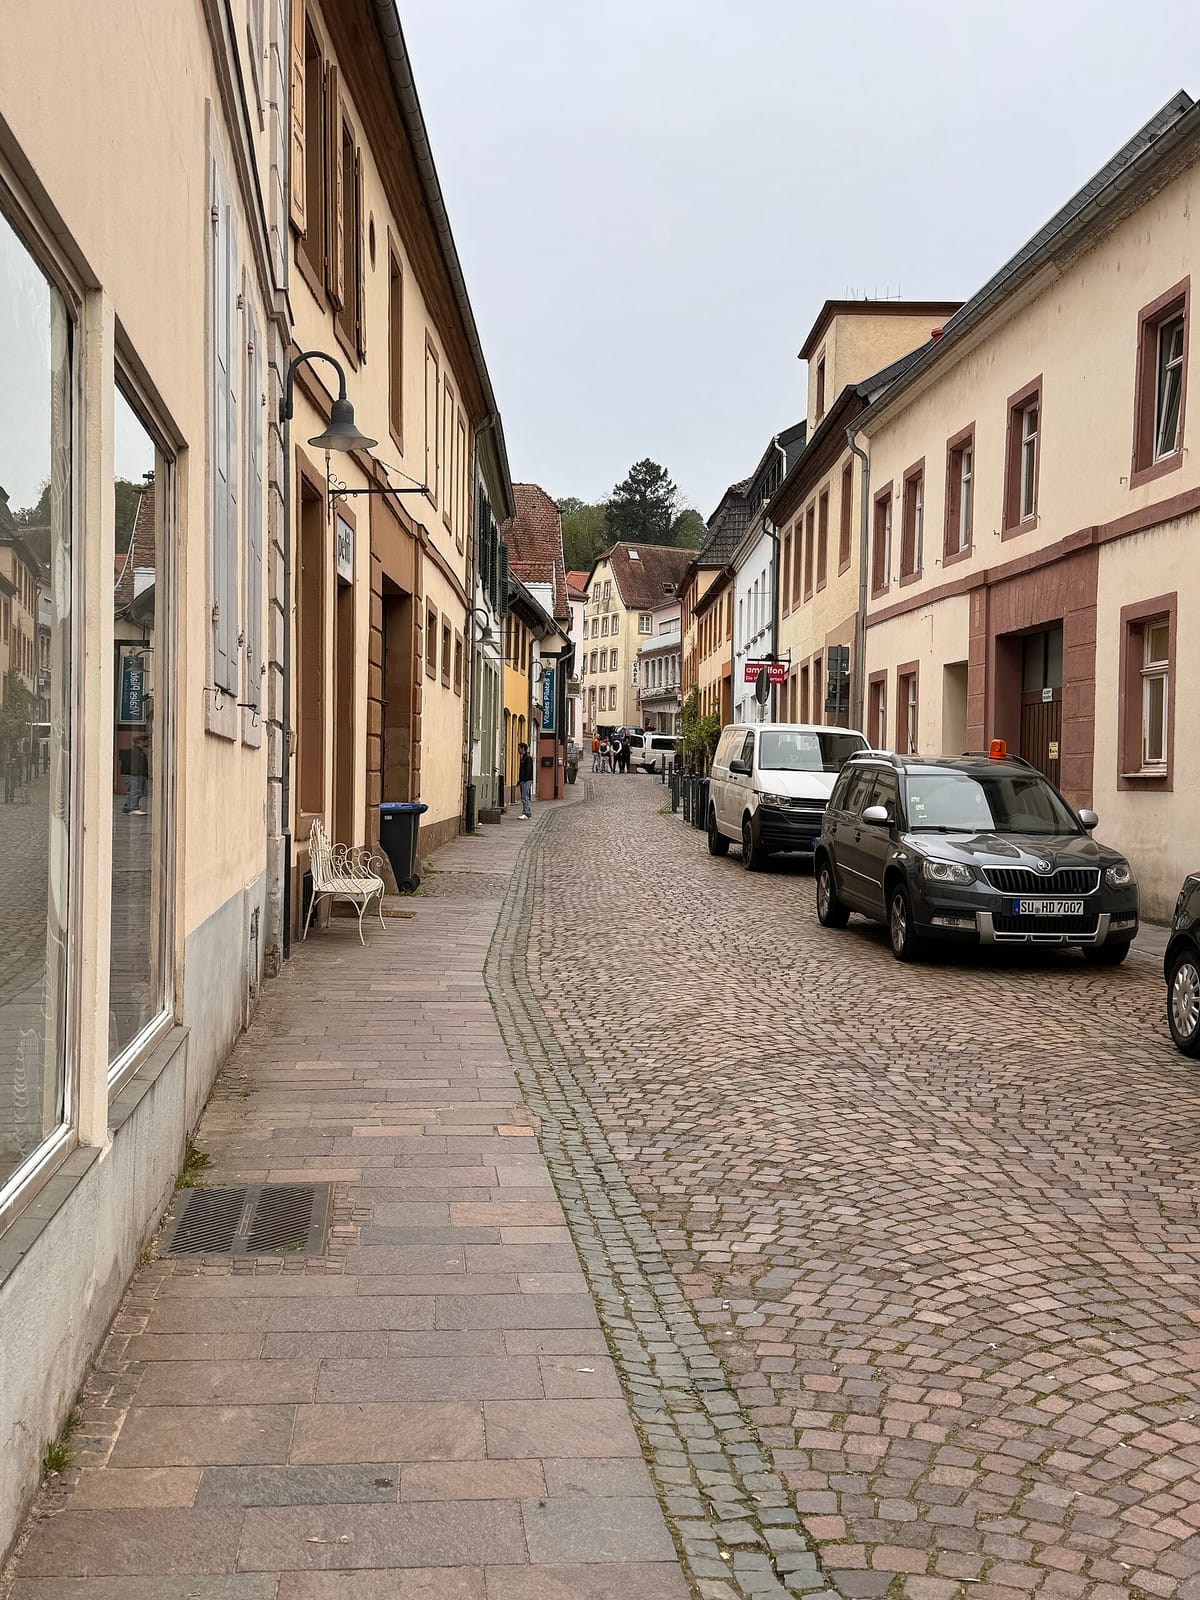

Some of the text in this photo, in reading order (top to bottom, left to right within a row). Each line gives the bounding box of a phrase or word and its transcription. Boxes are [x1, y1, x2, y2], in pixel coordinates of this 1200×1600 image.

[746, 666, 783, 674] amifon
[1020, 901, 1082, 913] SU HD 7007
